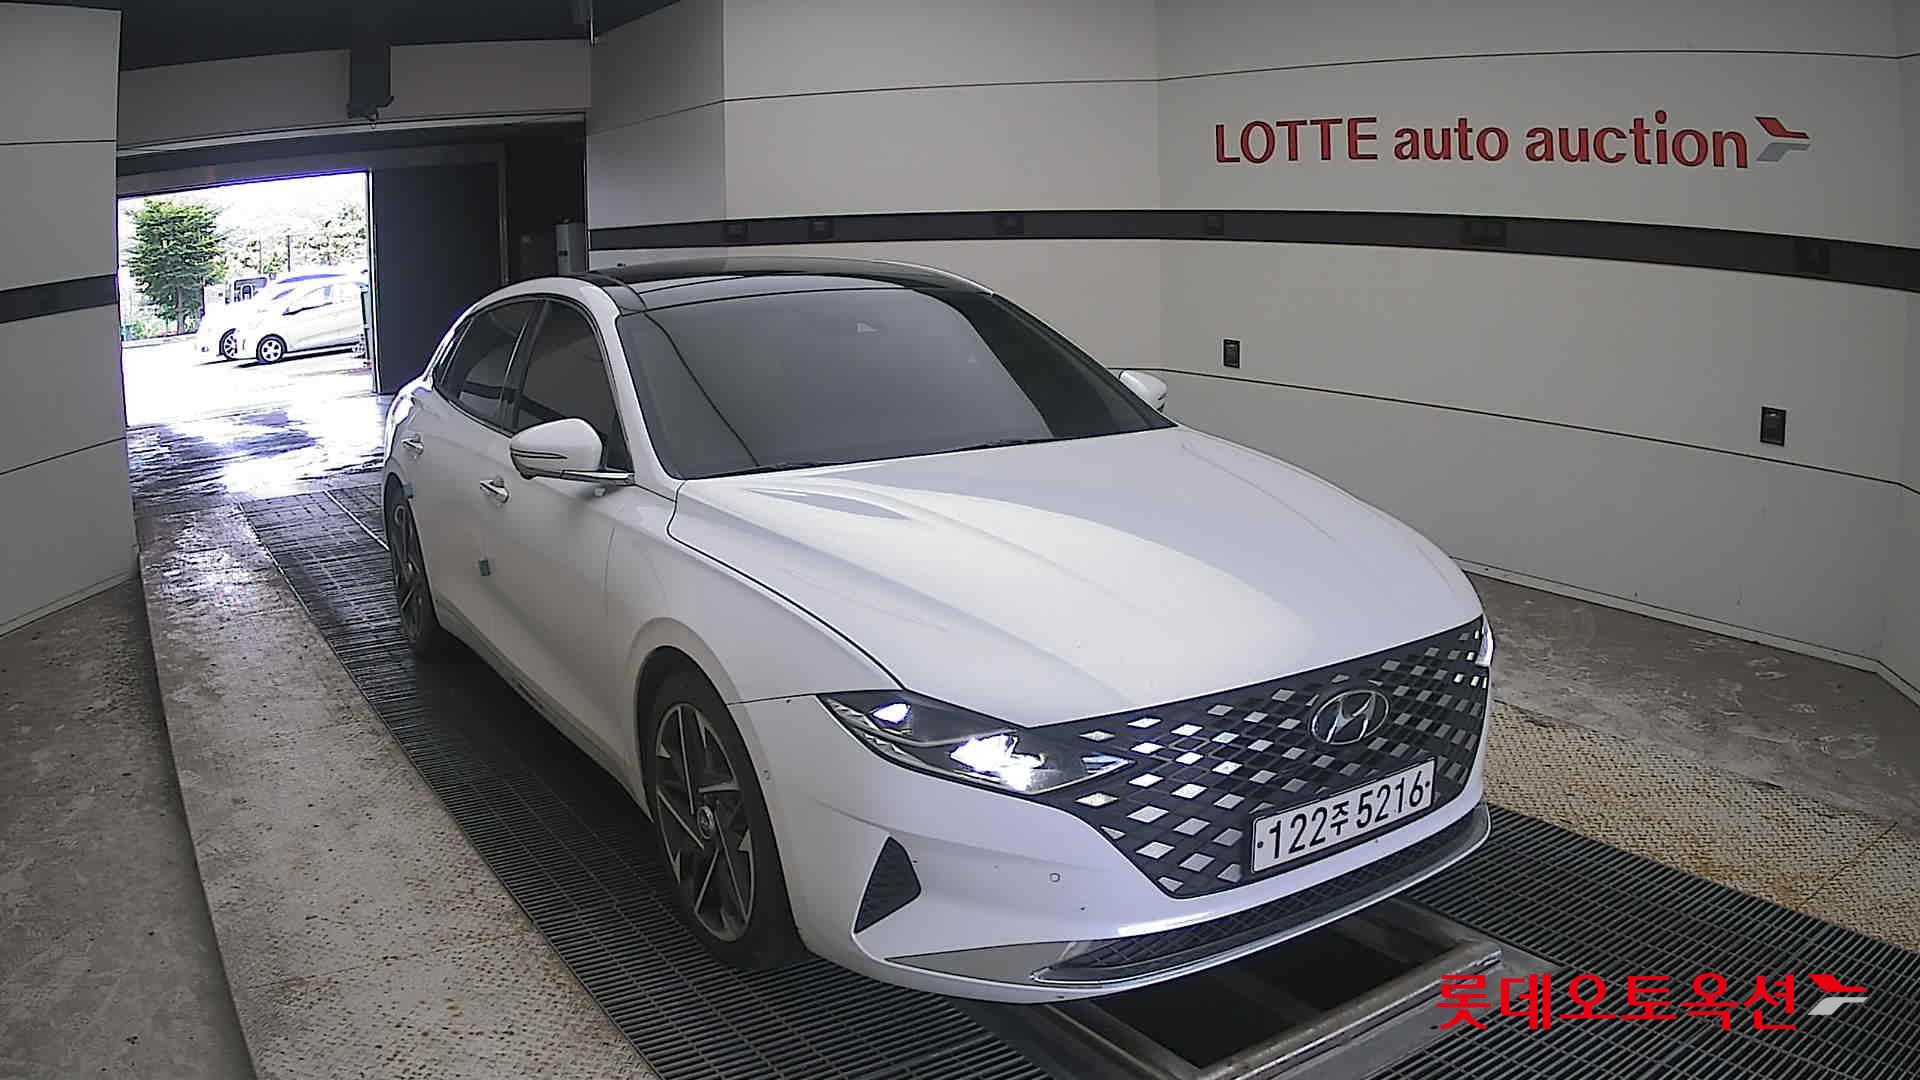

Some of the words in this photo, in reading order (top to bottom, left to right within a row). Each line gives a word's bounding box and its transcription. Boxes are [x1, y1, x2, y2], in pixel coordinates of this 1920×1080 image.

[1214, 116, 1378, 164] LOTTE
[1392, 117, 1510, 161] auto
[1524, 109, 1749, 169] auction
